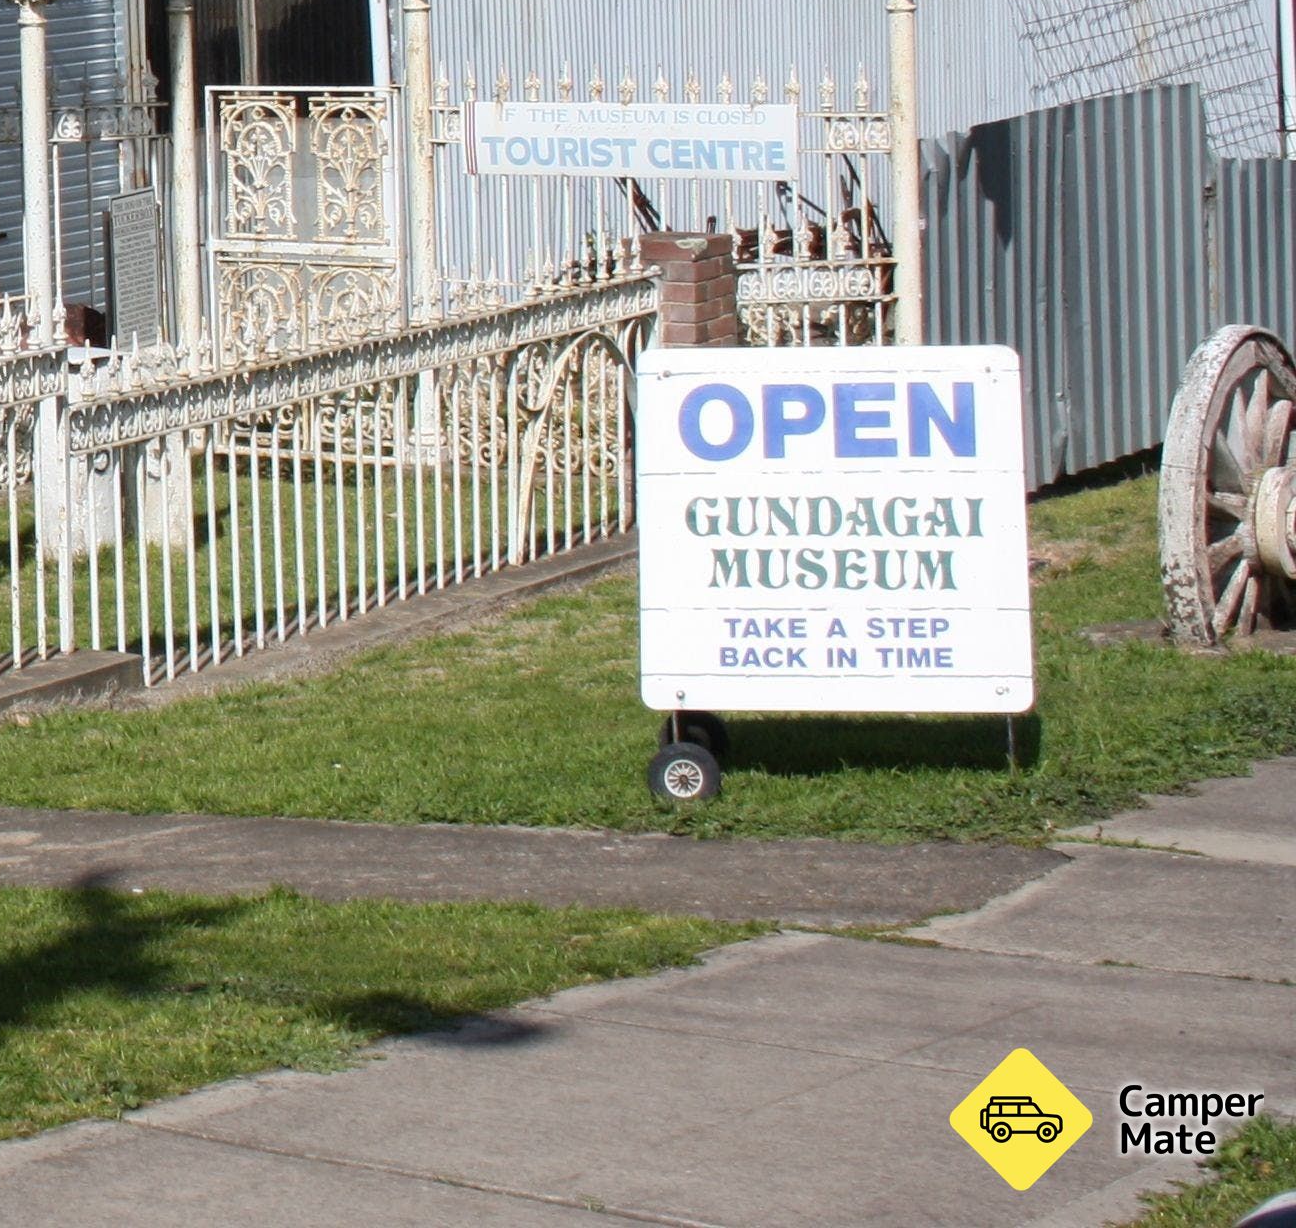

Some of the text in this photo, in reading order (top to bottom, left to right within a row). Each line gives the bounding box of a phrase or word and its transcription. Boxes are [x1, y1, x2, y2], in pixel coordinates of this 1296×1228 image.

[527, 108, 568, 122] THE
[577, 109, 665, 123] MUSEUM
[674, 110, 689, 124] IS
[697, 110, 766, 125] CLOSED
[481, 136, 786, 171] TOURIST CENTRE
[678, 381, 977, 462] OPEN
[684, 496, 985, 538] GUNDAGAI
[707, 548, 958, 590] MUSEUM
[724, 617, 951, 640] TAKE A STEP
[719, 647, 954, 668] BACK IN TIME
